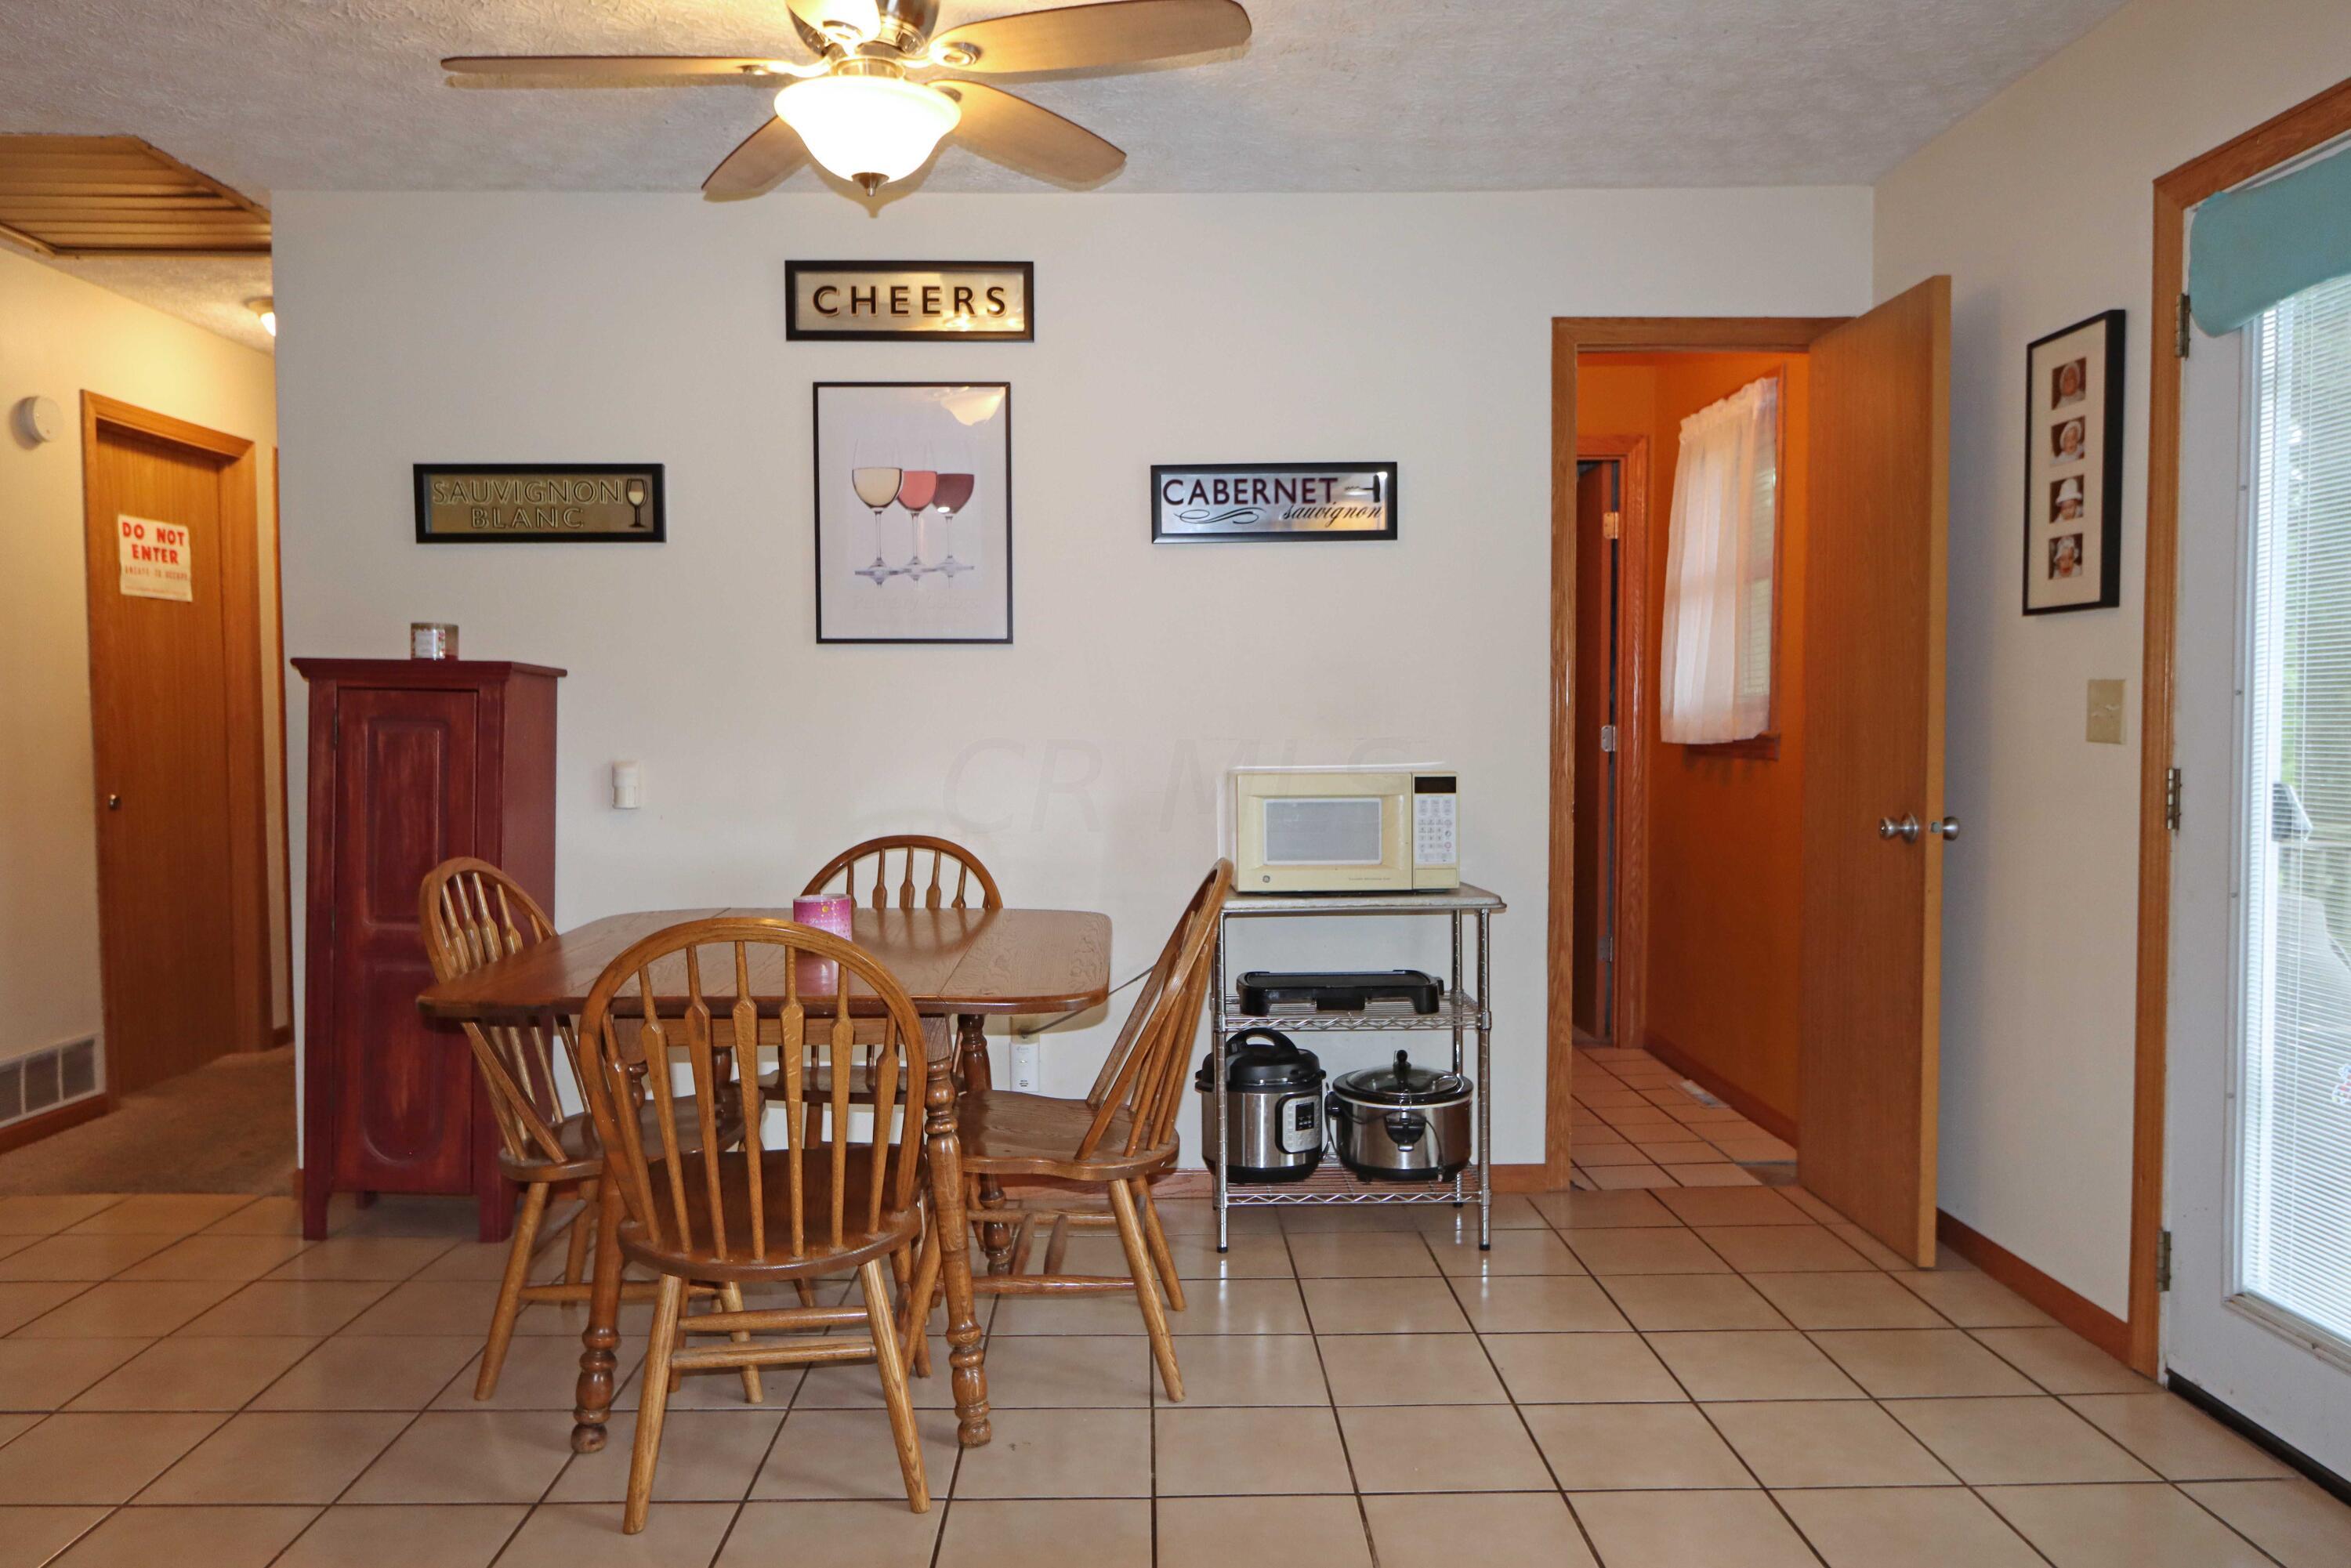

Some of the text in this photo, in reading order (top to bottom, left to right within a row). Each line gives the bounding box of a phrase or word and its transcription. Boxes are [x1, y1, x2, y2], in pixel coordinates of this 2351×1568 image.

[813, 285, 1006, 316] CHEERS
[433, 479, 624, 505] SAUVIGNON
[1162, 478, 1339, 505] CABERNET
[470, 508, 585, 529] BLANC
[1282, 502, 1382, 528] sauvignon
[122, 522, 185, 546] DO NOT
[132, 544, 179, 564] ENTER
